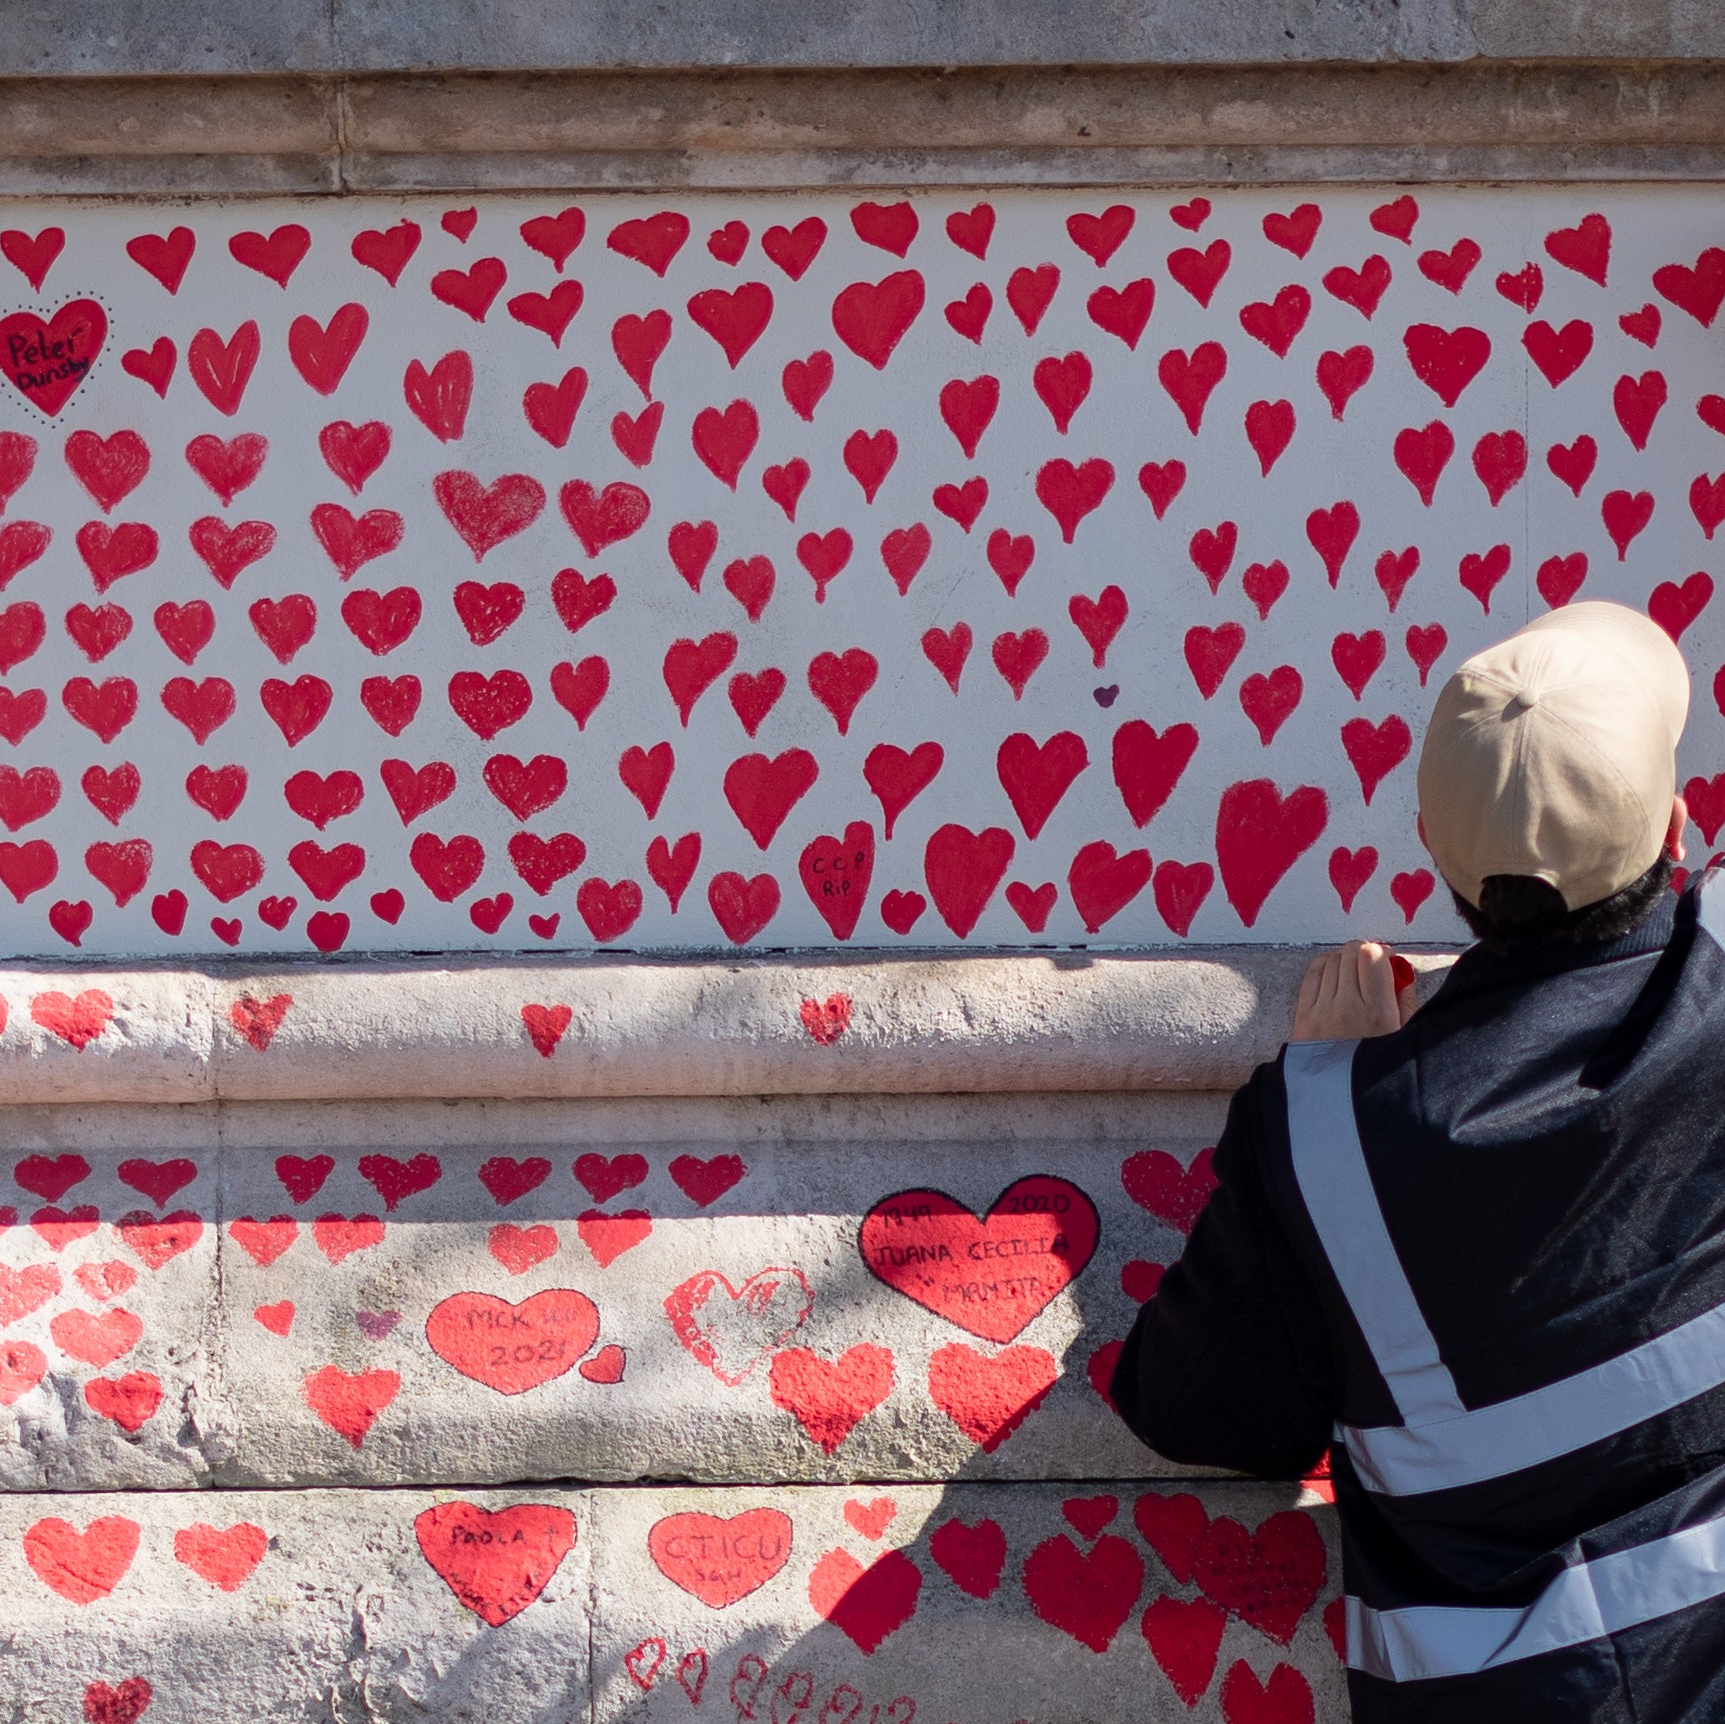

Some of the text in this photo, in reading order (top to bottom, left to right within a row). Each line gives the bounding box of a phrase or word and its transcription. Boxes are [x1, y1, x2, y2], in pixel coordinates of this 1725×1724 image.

[8, 328, 83, 367] Peter
[16, 356, 88, 391] Dunsby
[1009, 1193, 1071, 1214] 2020
[873, 1232, 1070, 1268] JUANA CECILIA
[491, 1339, 566, 1366] 2021
[452, 1526, 527, 1549] PAOLA
[665, 1534, 781, 1561] CTICU
